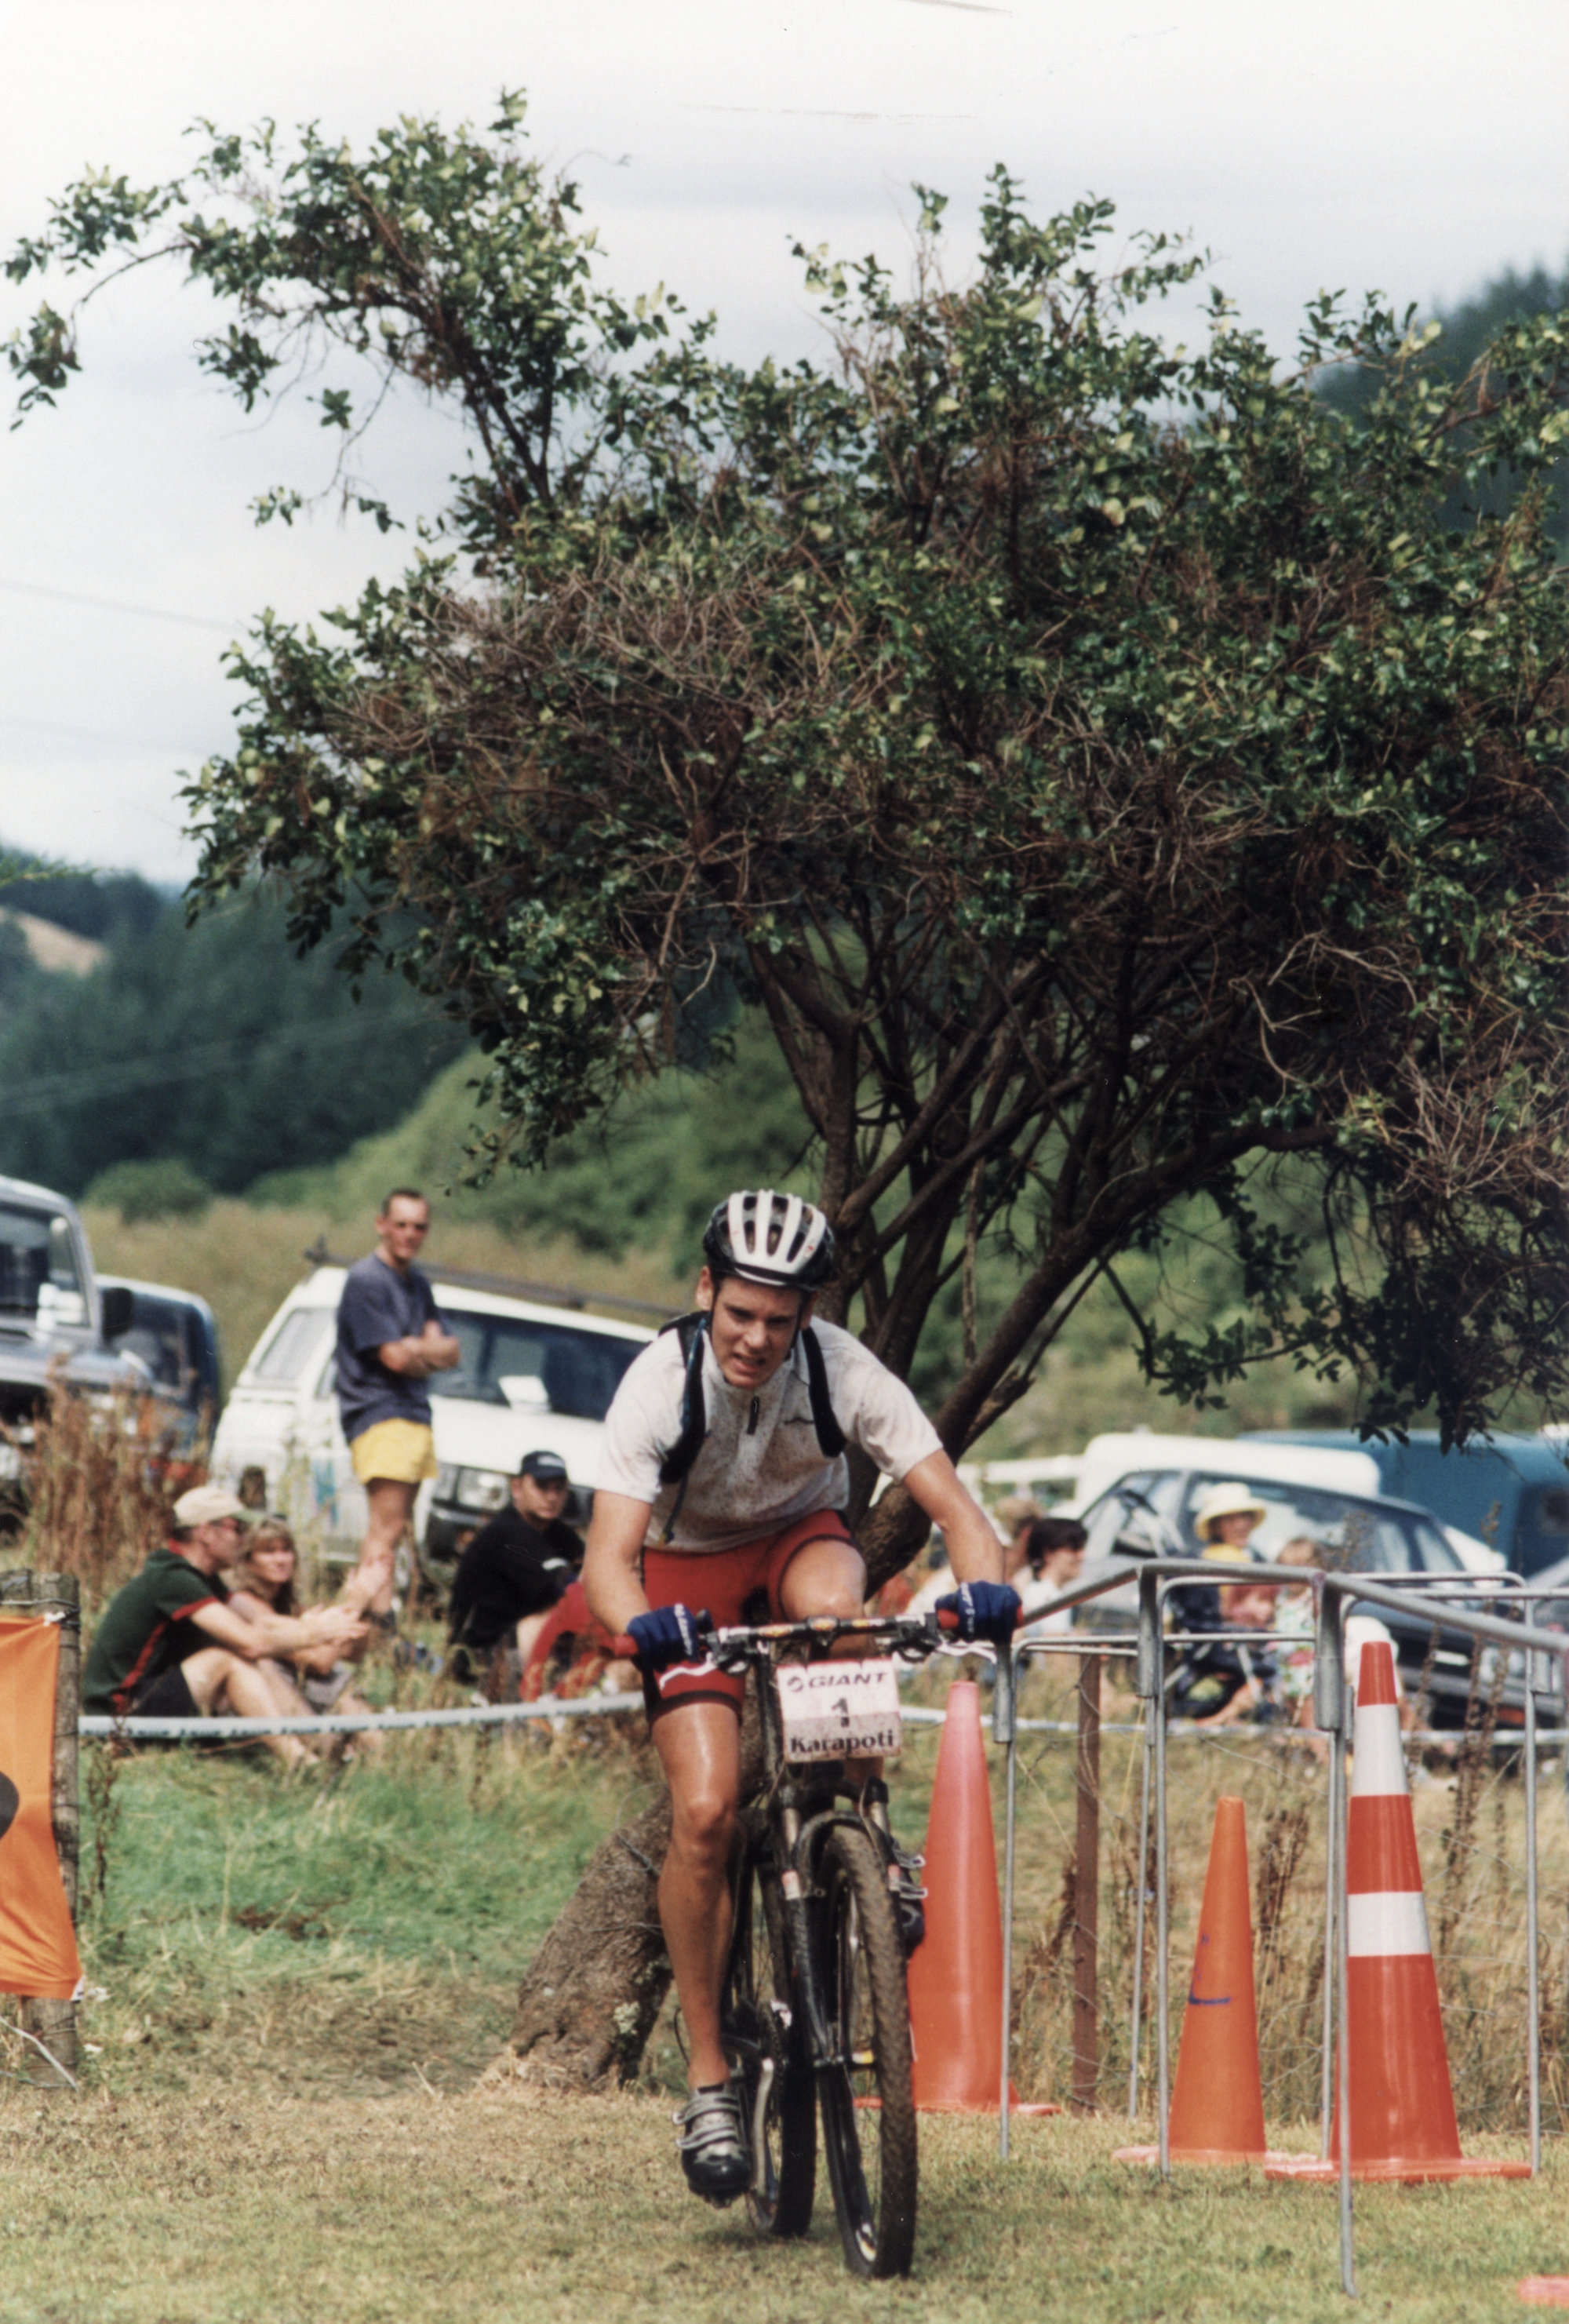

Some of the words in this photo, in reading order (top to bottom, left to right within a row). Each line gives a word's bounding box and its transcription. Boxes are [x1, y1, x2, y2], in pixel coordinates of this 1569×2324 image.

[809, 1672, 887, 1688] GIANT
[831, 1697, 850, 1728] 1
[790, 1728, 894, 1756] Karapoti
